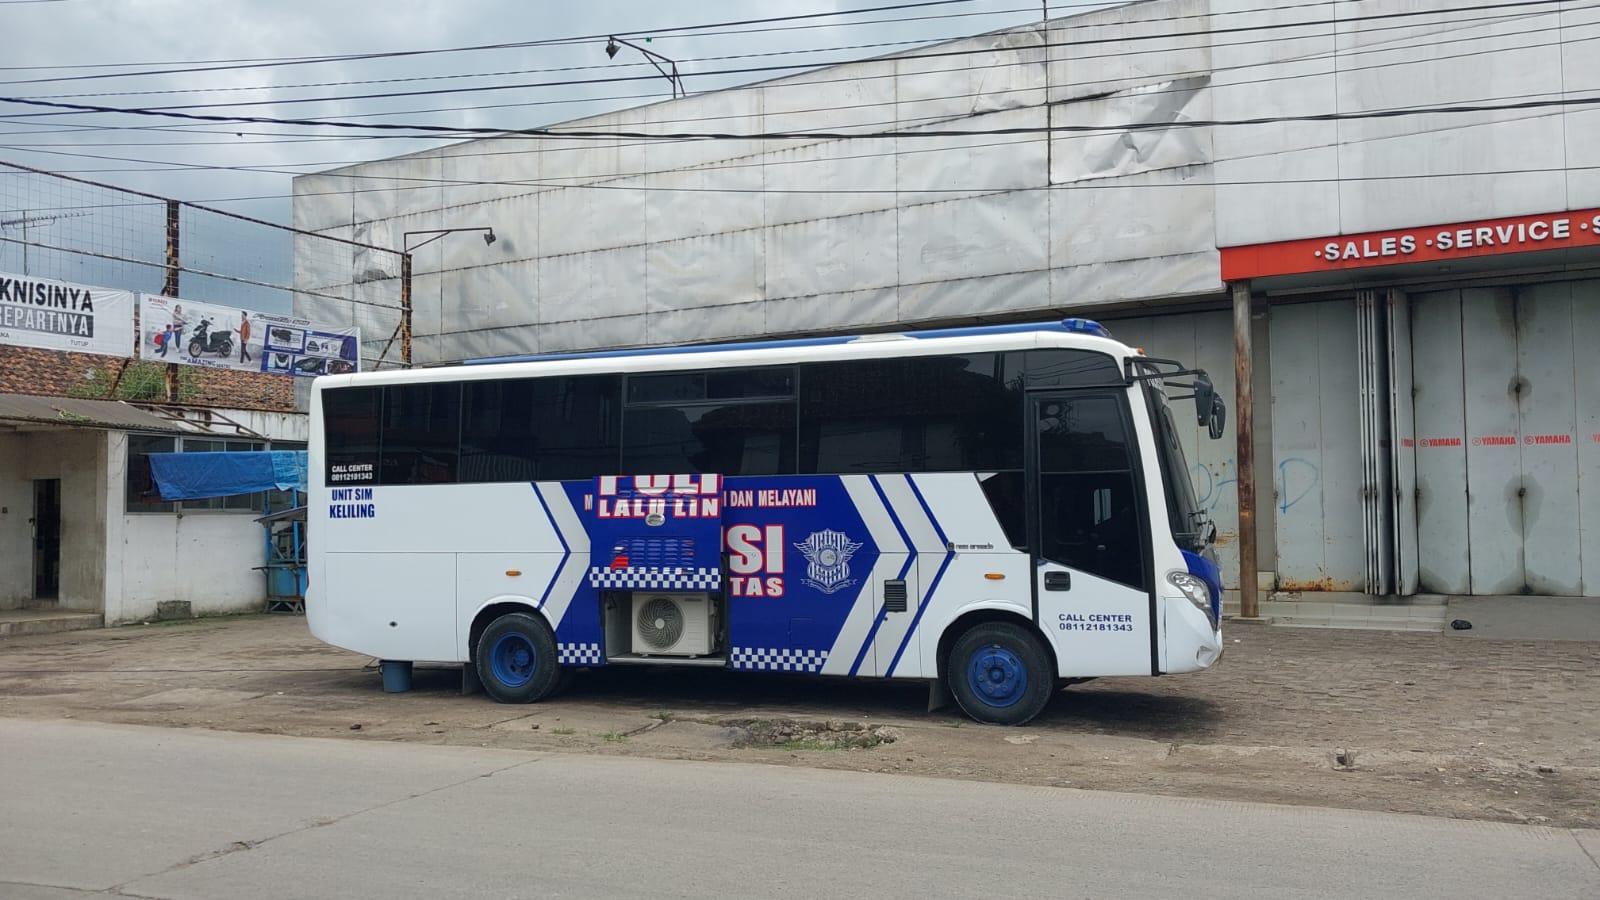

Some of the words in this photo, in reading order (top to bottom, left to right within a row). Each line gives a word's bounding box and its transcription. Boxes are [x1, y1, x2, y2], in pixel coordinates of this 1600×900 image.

[1324, 235, 1416, 261] SALES
[1436, 219, 1570, 250] SERVICE
[1429, 437, 1462, 447] YAMAHA
[1481, 435, 1517, 446] YAMAHA
[1535, 434, 1571, 444] YAMAHA
[332, 465, 347, 473] CALL
[348, 464, 373, 472] CENTER
[331, 488, 353, 502] UNIT
[354, 487, 373, 501] SIM
[730, 490, 754, 507] DAN
[758, 488, 817, 506] MELAYANI
[329, 503, 375, 519] KELILING
[673, 498, 719, 517] LIN
[726, 524, 784, 575] SI
[729, 576, 784, 597] TAS
[1058, 613, 1086, 622] CALL
[1088, 614, 1132, 622] CENTER
[1059, 622, 1133, 632] 08112181343
